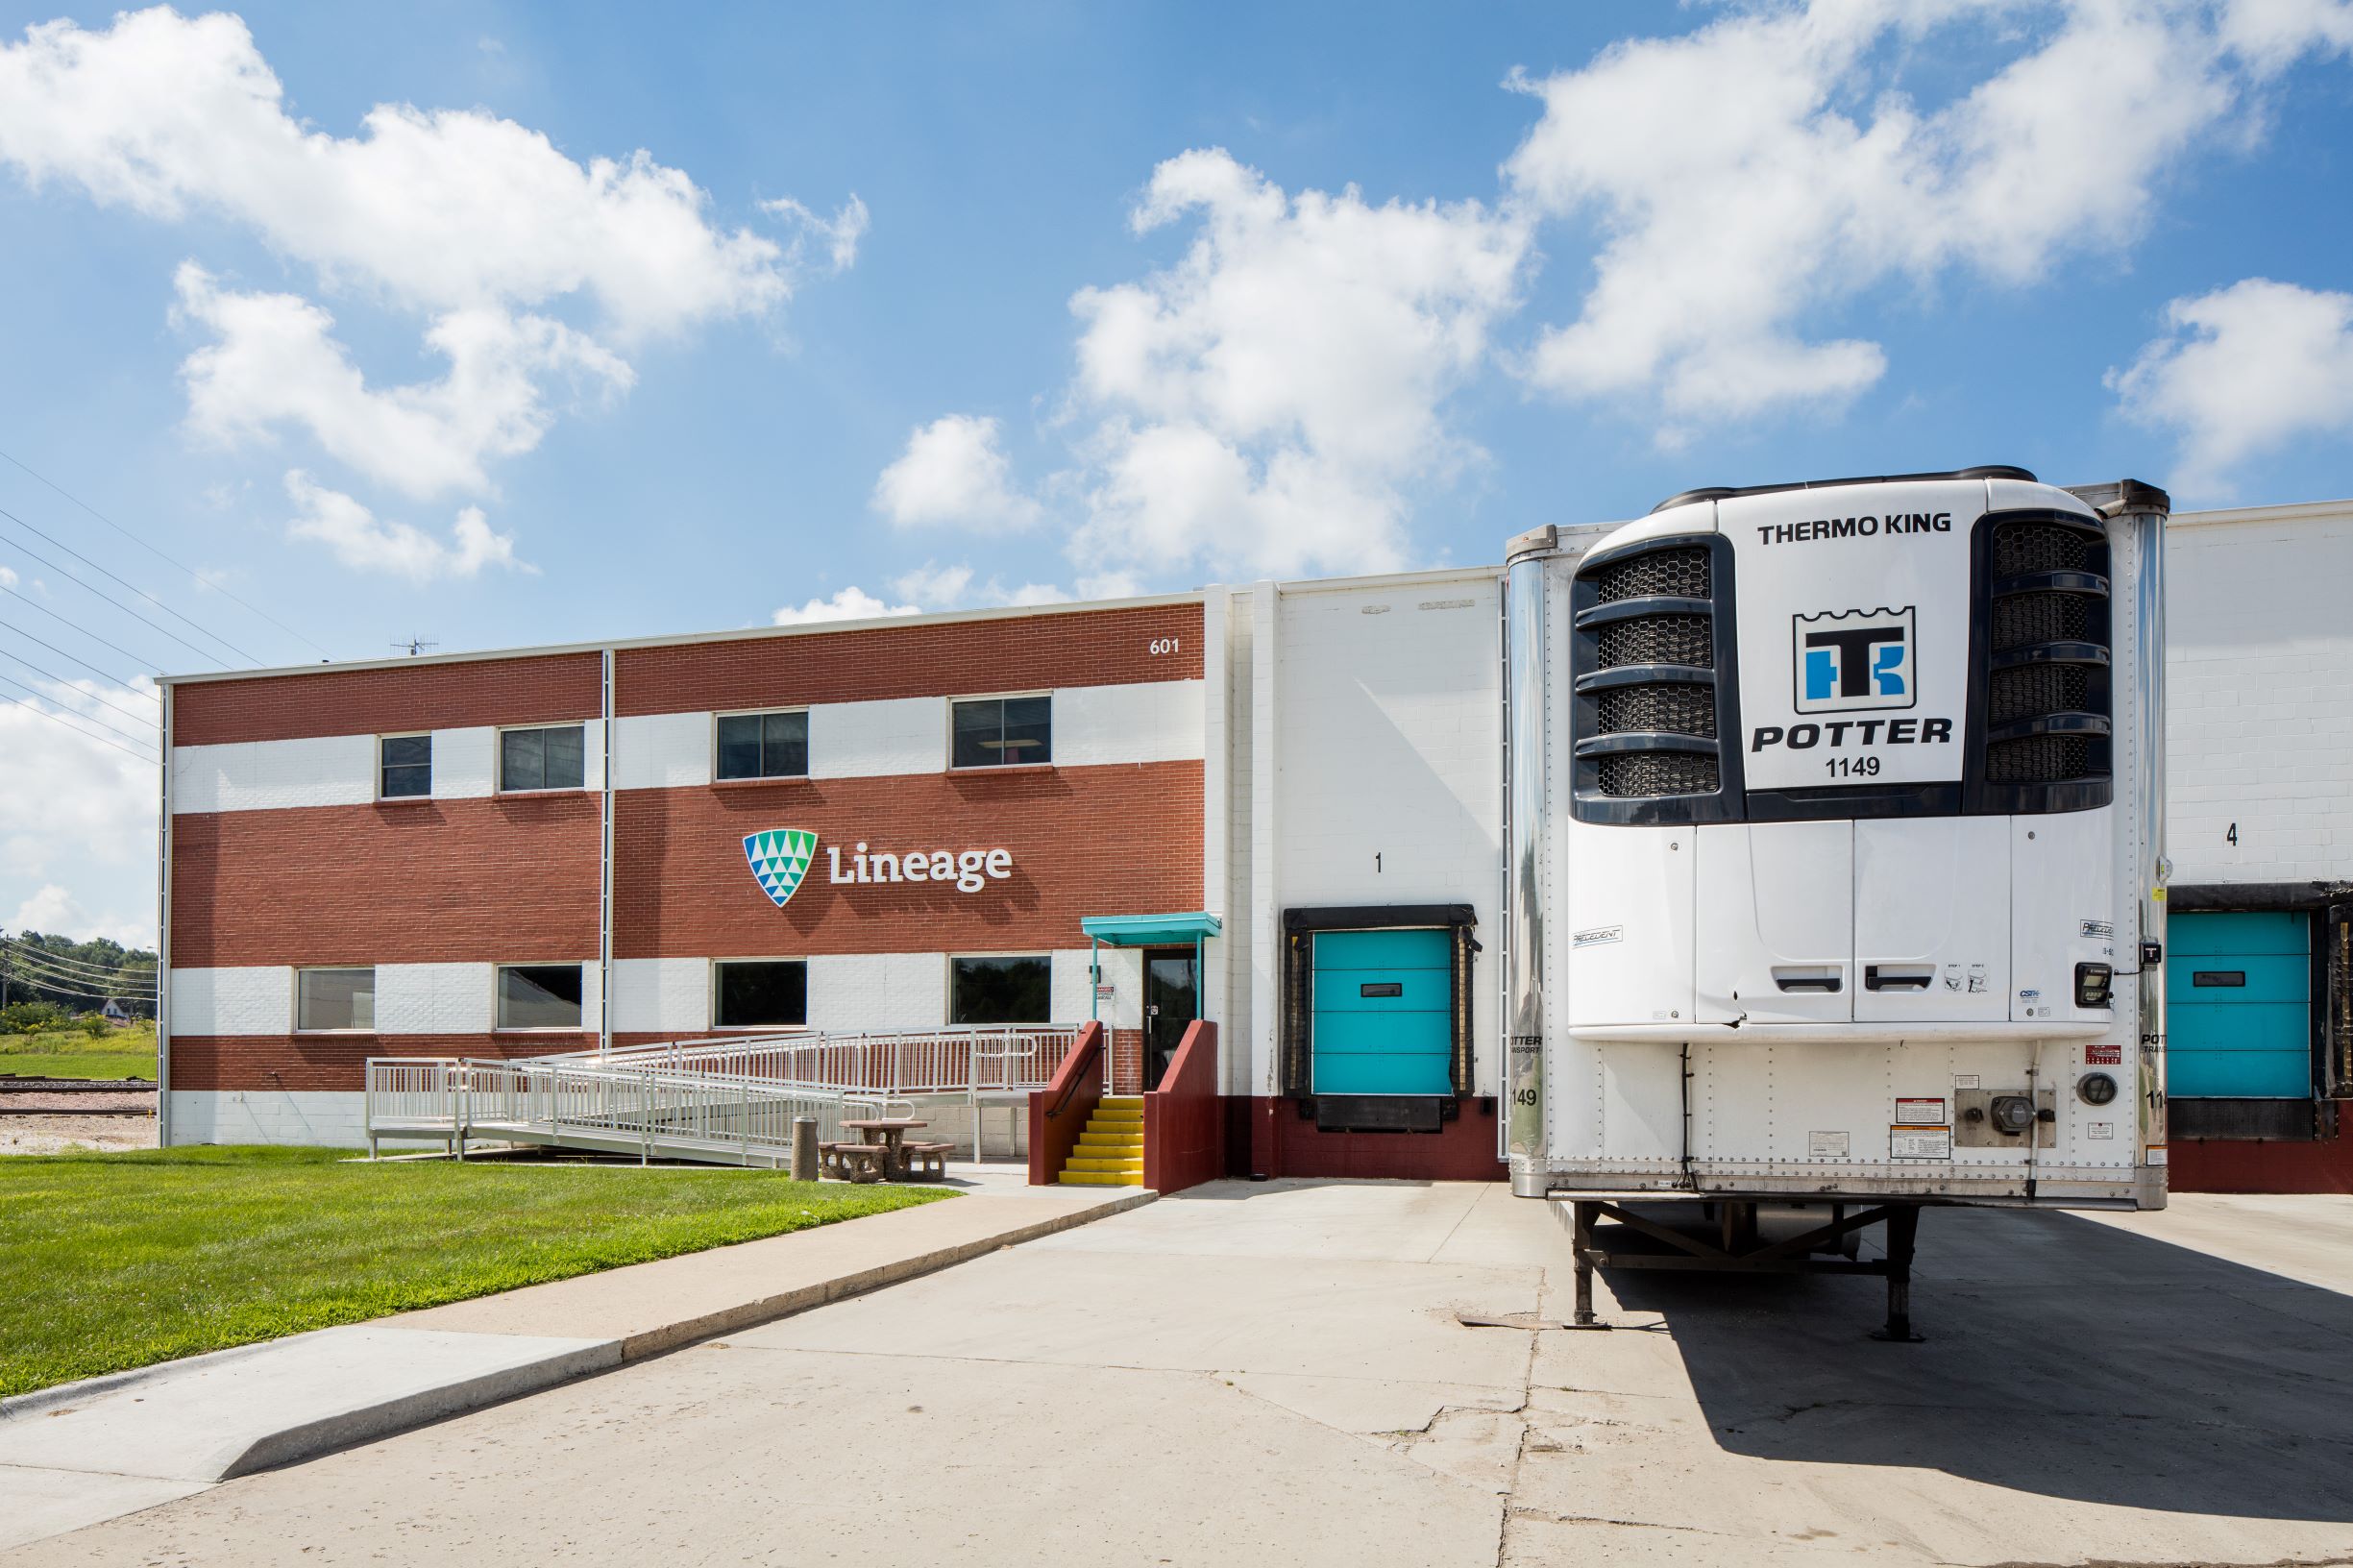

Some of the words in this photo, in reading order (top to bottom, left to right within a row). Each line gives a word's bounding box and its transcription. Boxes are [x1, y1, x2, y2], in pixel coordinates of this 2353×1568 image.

[1757, 516, 1878, 545] THERMO
[1885, 512, 1951, 534] KING
[1149, 638, 1179, 654] 601
[1752, 718, 1952, 753] POTTER
[1826, 756, 1880, 778] 1149
[2227, 822, 2238, 846] 4
[827, 842, 1013, 894] Lineage
[1375, 851, 1382, 873] 1
